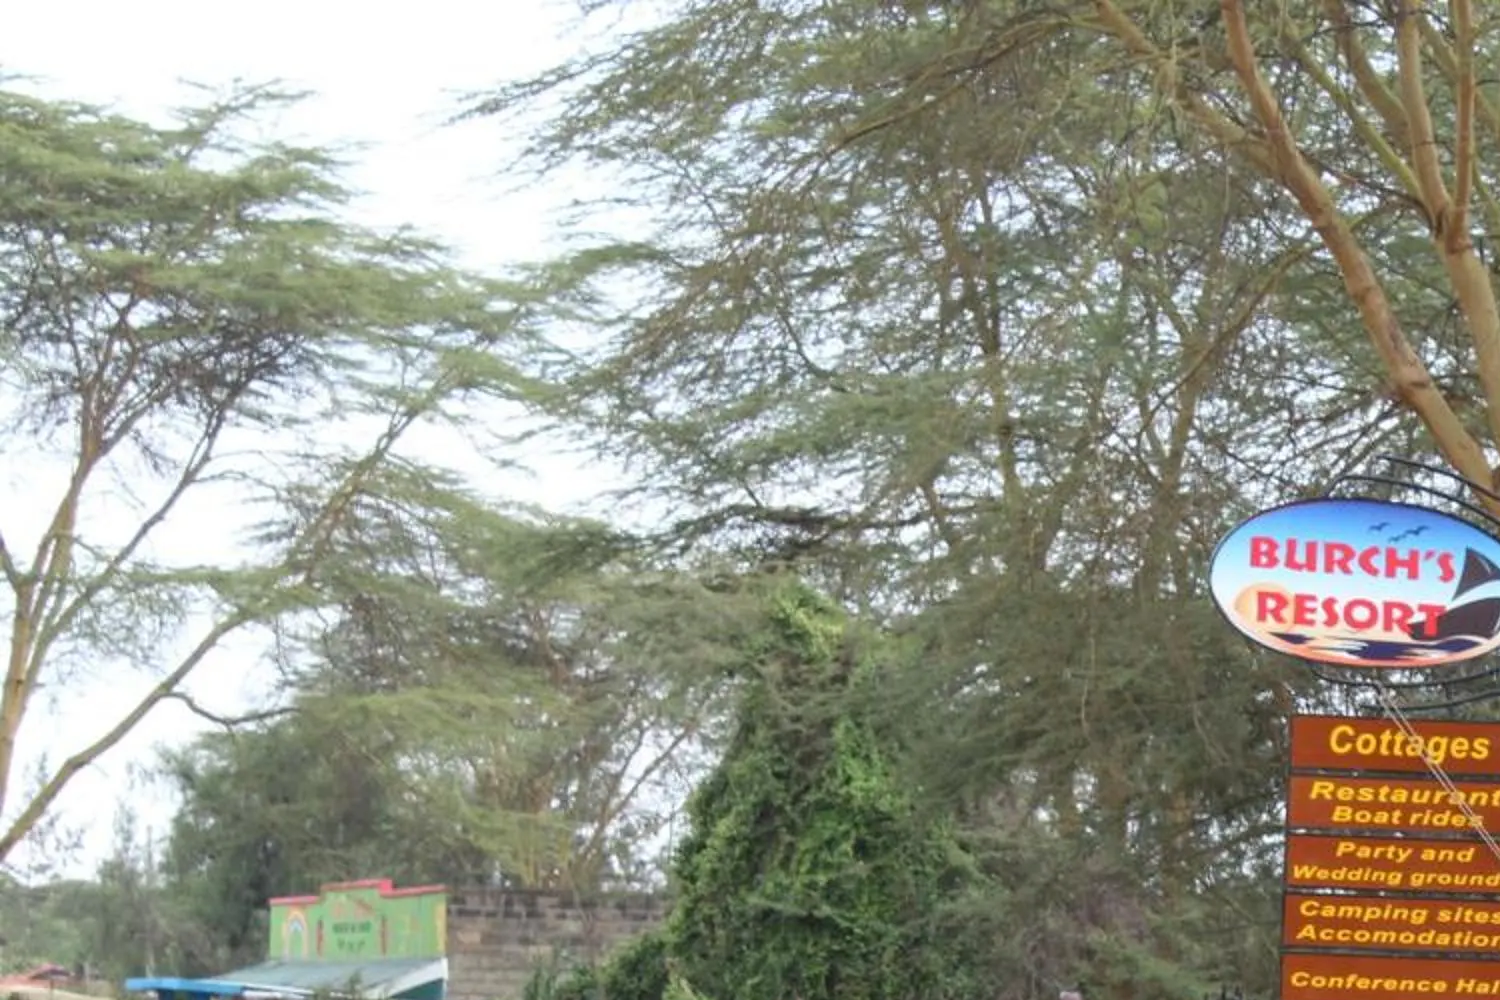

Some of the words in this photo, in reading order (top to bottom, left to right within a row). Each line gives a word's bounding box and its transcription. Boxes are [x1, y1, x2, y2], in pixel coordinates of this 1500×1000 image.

[1249, 536, 1456, 582] BURCH'S
[1256, 590, 1447, 638] RESORT
[1329, 724, 1491, 765] Cottages
[1332, 805, 1402, 826] Boat
[1409, 810, 1484, 828] rides
[1336, 841, 1412, 863] Party
[1420, 847, 1475, 863] and
[1293, 864, 1402, 885] Wedding
[1299, 900, 1429, 925] Camping
[1290, 971, 1448, 993] Conference
